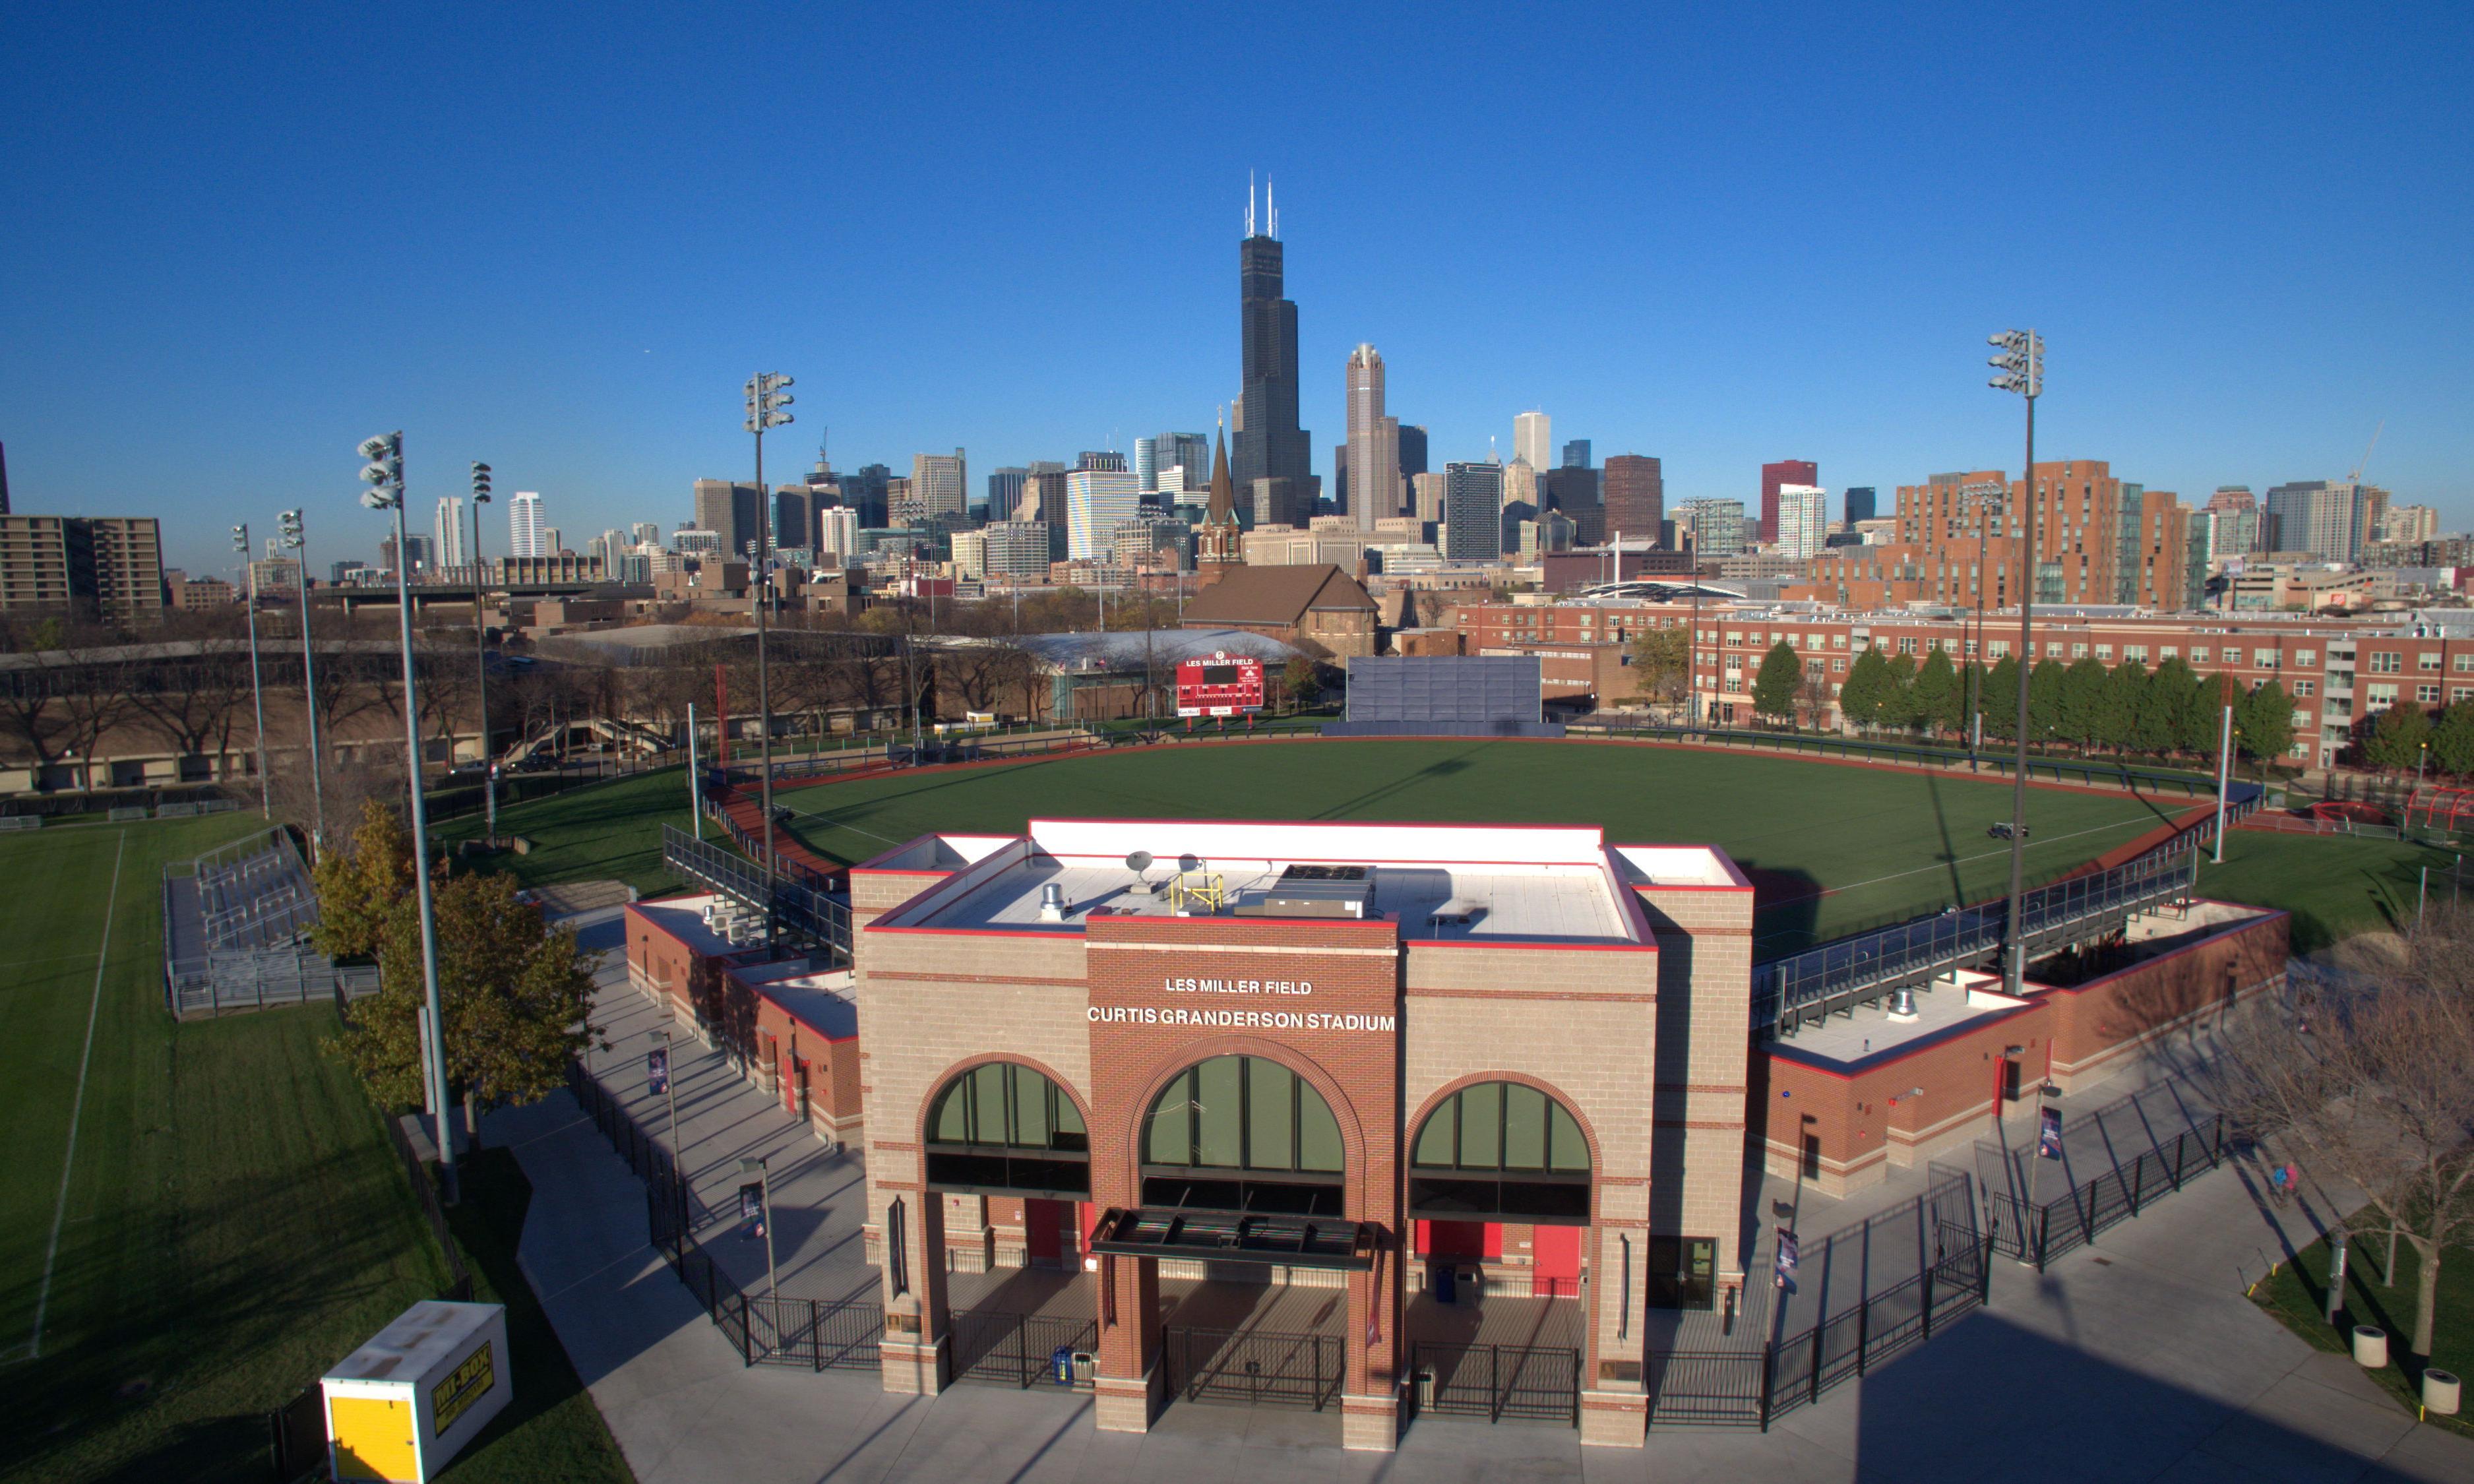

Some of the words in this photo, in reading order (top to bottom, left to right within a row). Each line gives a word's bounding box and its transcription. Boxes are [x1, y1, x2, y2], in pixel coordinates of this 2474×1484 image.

[1165, 978, 1196, 991] LES
[1200, 979, 1260, 993] MILLER
[1265, 981, 1312, 995] FIELD
[1087, 1006, 1157, 1024] CURTIS
[1159, 1009, 1303, 1028] GRANDERSON
[1307, 1013, 1396, 1032] STADIUM
[435, 1347, 489, 1407] MI-BOX
